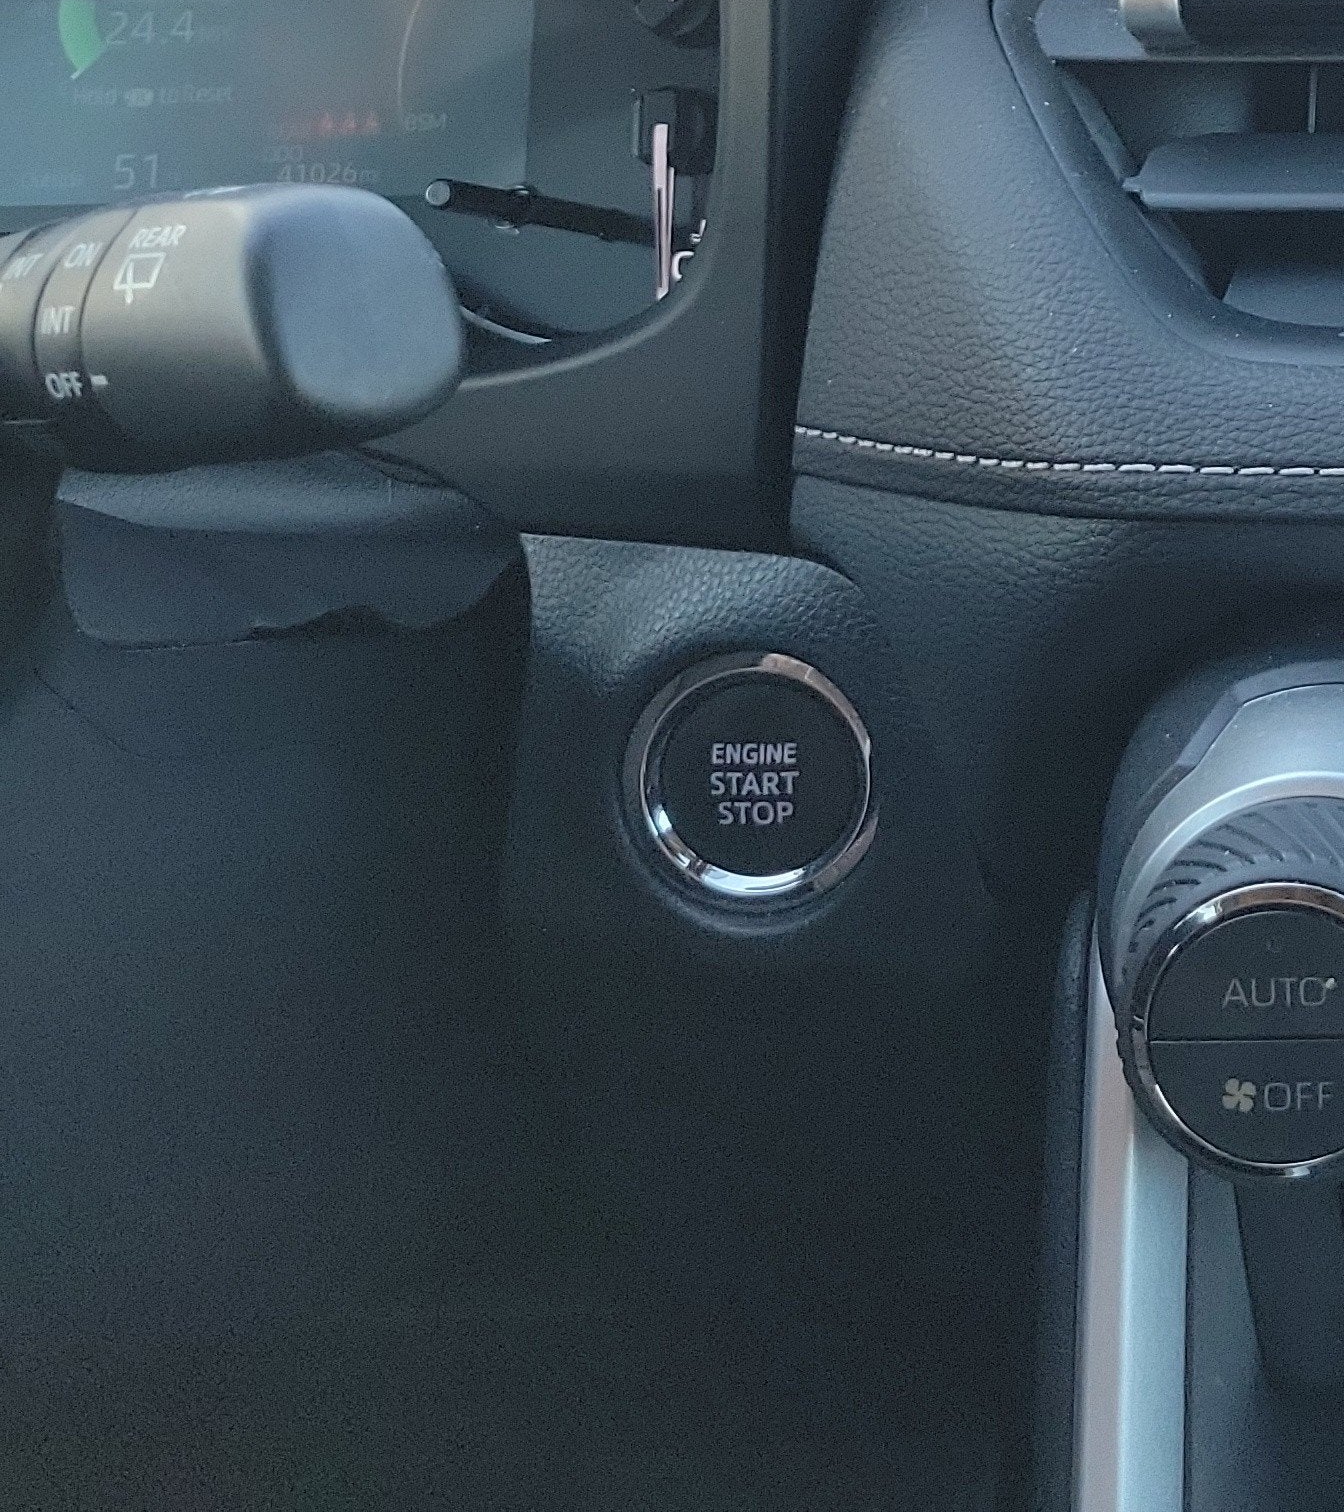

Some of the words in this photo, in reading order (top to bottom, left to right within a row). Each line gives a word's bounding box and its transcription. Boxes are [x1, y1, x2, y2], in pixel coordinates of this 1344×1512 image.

[104, 9, 195, 45] 24.4
[112, 152, 160, 191] 51
[128, 224, 187, 250] REAR
[63, 243, 102, 269] ON
[41, 305, 75, 335] INT
[45, 370, 84, 400] OFF
[711, 742, 798, 766] ENGINE
[710, 771, 800, 796] START
[718, 801, 795, 826] STOP
[1222, 975, 1327, 1009] AUTO
[1262, 1080, 1335, 1113] OFF
